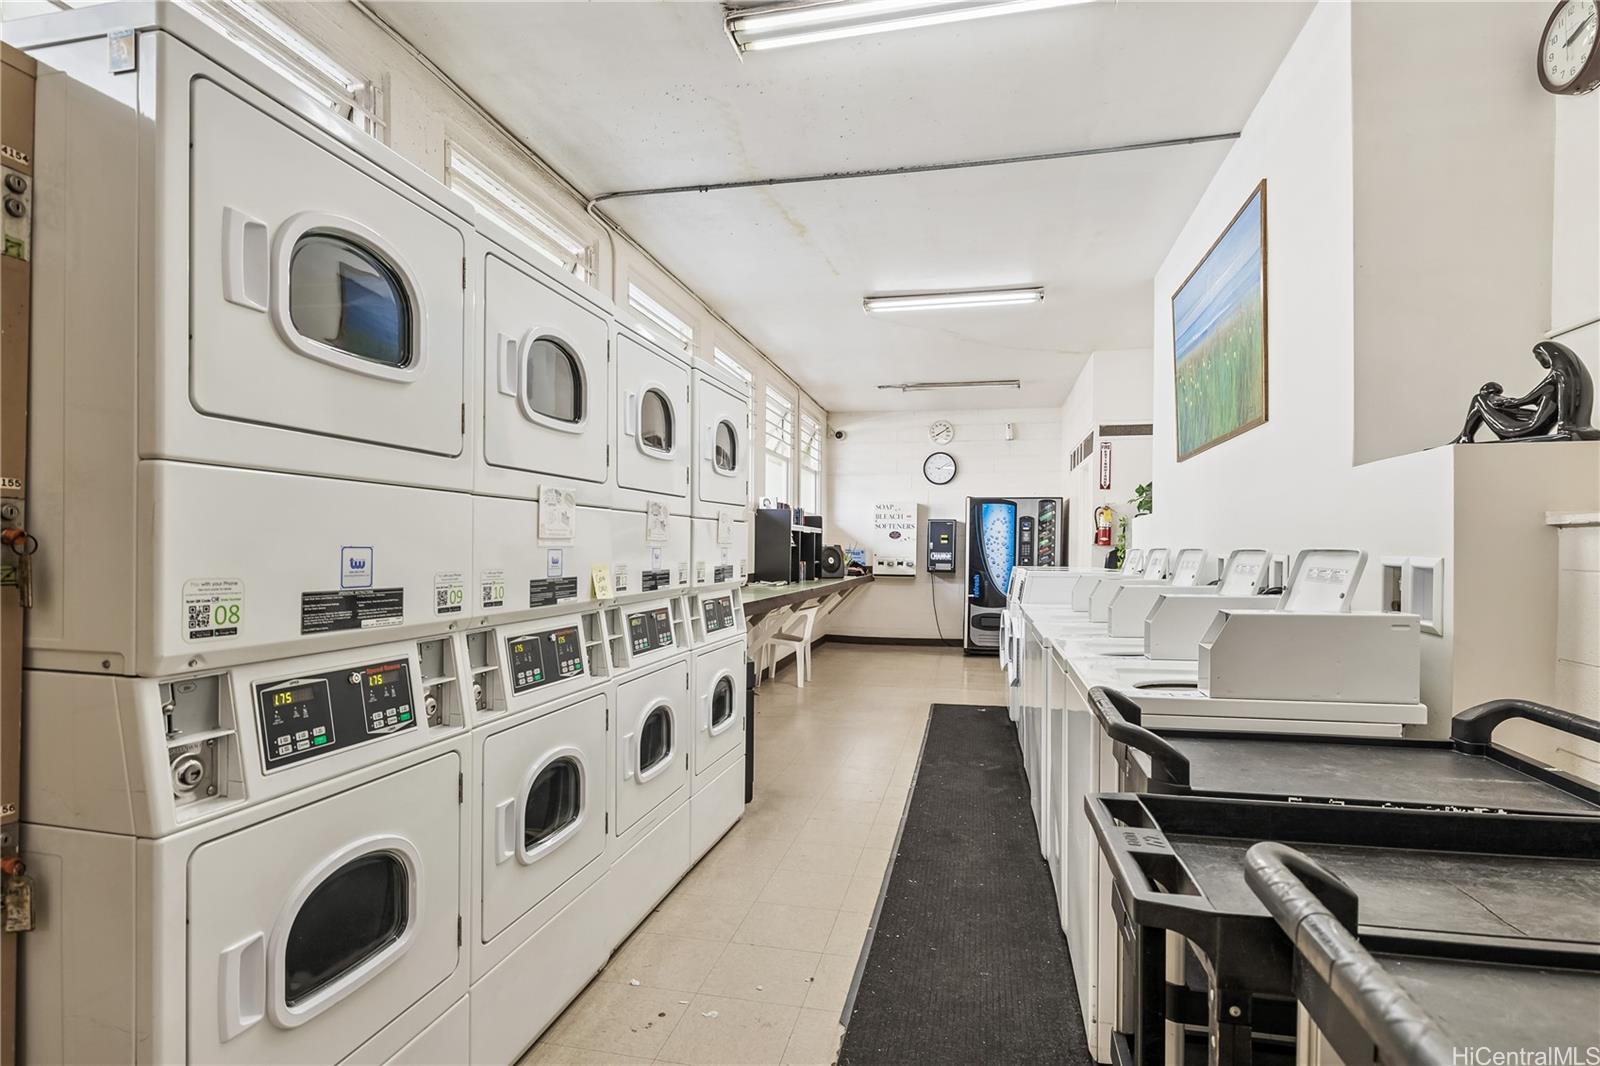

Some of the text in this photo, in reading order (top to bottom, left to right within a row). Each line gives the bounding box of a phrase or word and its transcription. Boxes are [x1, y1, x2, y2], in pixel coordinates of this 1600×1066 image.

[1552, 34, 1558, 46] 10
[1548, 52, 1554, 62] 9
[1552, 64, 1558, 75] 8
[1560, 69, 1565, 79] 7
[1570, 66, 1576, 76] 6
[875, 503, 895, 511] SOAP
[874, 522, 916, 530] SOFTENERS
[449, 590, 463, 605] 09
[494, 586, 505, 600] 10
[214, 604, 240, 625] 08
